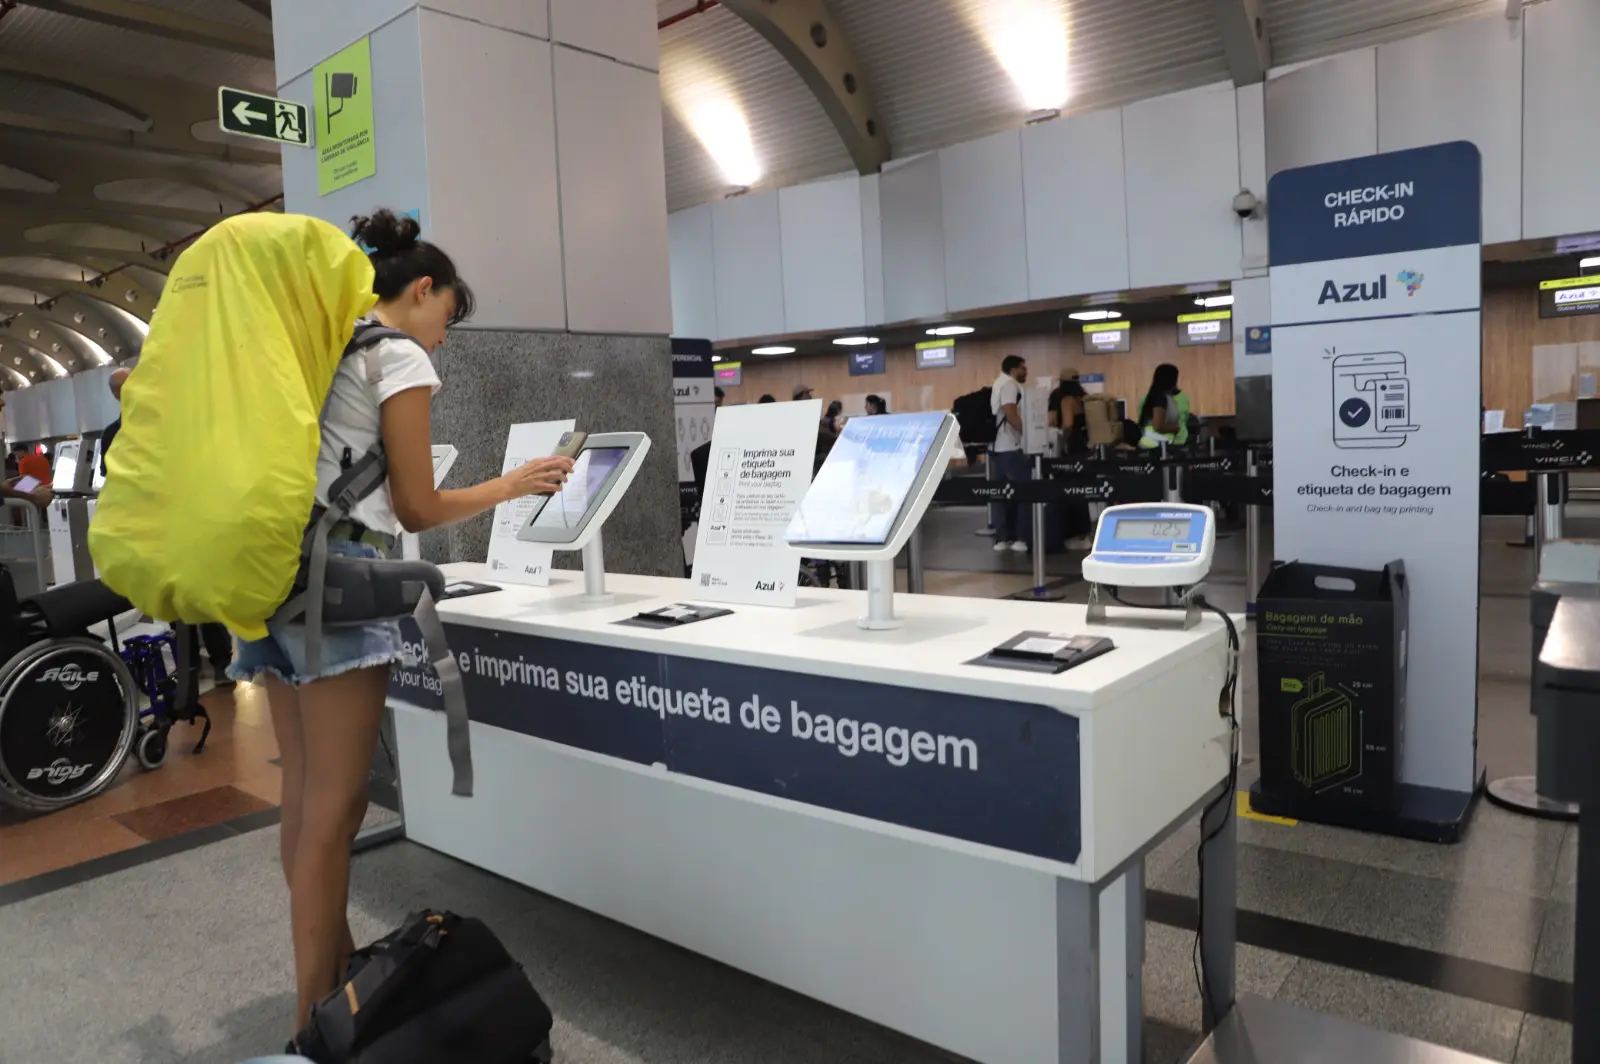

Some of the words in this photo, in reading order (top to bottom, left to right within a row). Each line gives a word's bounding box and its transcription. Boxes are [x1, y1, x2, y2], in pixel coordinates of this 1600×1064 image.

[1324, 181, 1414, 208] CHECK-IN
[1334, 204, 1405, 228] RÁPIDO
[1317, 273, 1387, 305] Azul
[743, 448, 778, 460] Imprima
[779, 449, 795, 457] sua
[1534, 455, 1574, 463] VINCI
[741, 459, 775, 469] etiqueta
[740, 470, 750, 479] de
[751, 470, 792, 480] bagagem
[1330, 464, 1397, 477] Check-in
[1400, 466, 1410, 477] e
[972, 487, 1001, 495] VINCI
[1064, 486, 1098, 495] VINCI
[1297, 483, 1353, 497] etiqueta
[1357, 483, 1376, 496] de
[1379, 483, 1452, 498] bagagem
[1306, 503, 1344, 513] Check-in
[1345, 504, 1362, 513] and
[1364, 504, 1382, 515] bag
[1383, 504, 1398, 515] tag
[1399, 504, 1434, 515] printing
[524, 564, 538, 574] Azul
[755, 581, 776, 591] Azul
[1265, 611, 1316, 624] Bagagem
[1320, 614, 1335, 624] de
[1338, 613, 1363, 625] mão
[36, 667, 99, 683] AGILE
[400, 669, 420, 688] your
[459, 651, 471, 672] e
[474, 647, 560, 692] imprima
[565, 670, 609, 701] sua
[615, 676, 731, 724] etiqueta
[739, 693, 781, 734] de
[790, 700, 978, 771] bagagem
